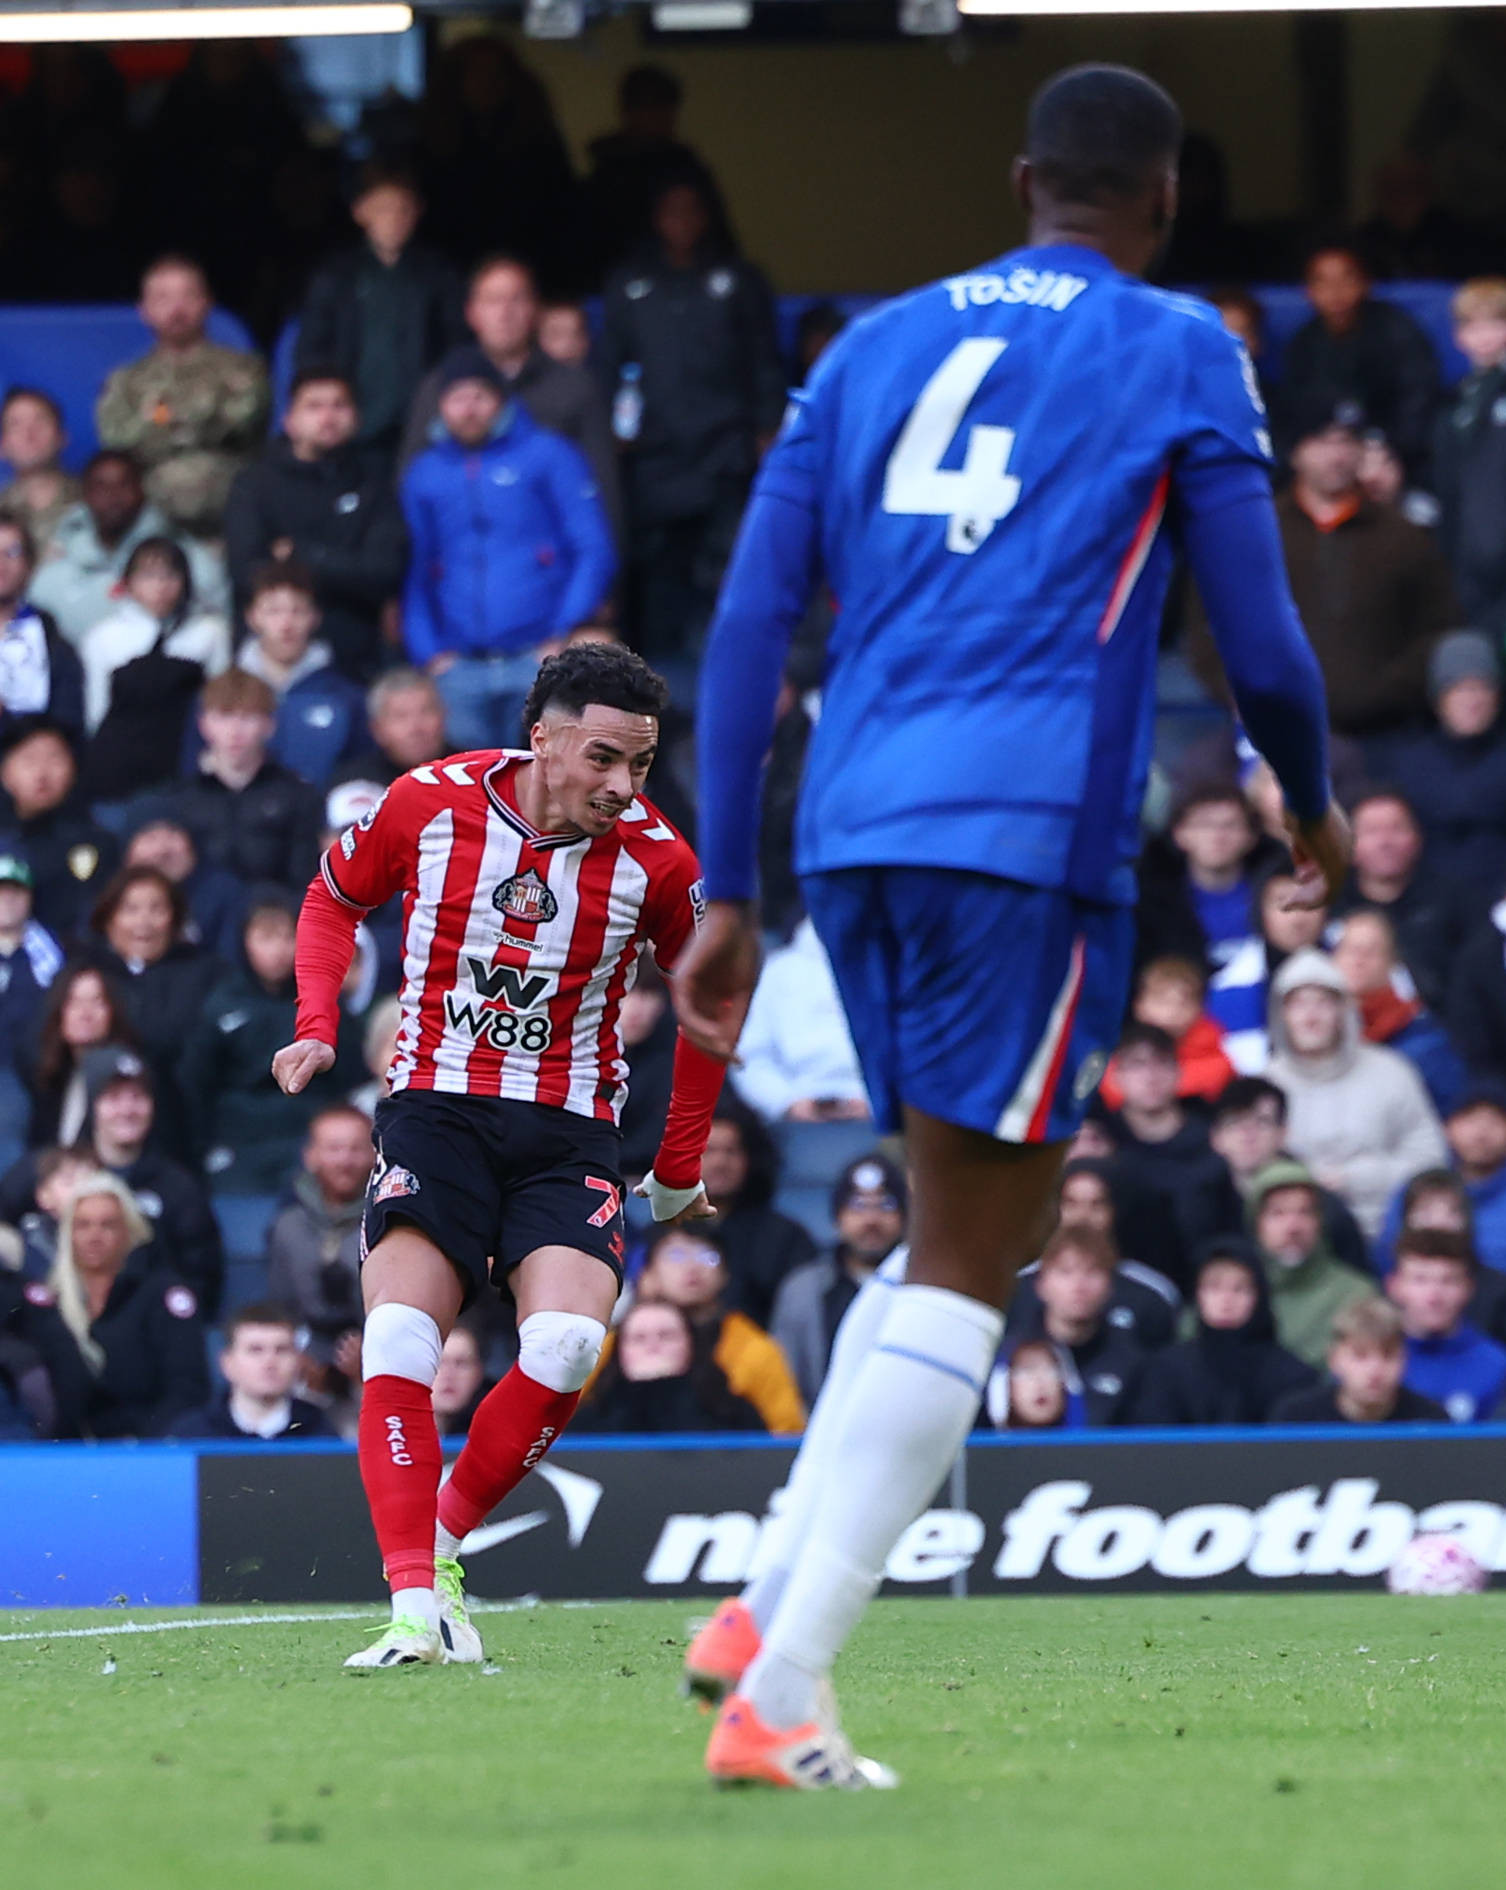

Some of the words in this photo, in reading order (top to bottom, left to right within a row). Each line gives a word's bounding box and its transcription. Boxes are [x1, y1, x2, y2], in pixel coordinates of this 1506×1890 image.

[942, 266, 1089, 312] TOSIN
[881, 336, 1022, 555] 4
[504, 934, 544, 953] hummel
[446, 994, 550, 1053] W88
[585, 1175, 620, 1229] 7
[384, 1415, 414, 1467] SAFC
[522, 1426, 556, 1469] SAFC
[643, 1484, 987, 1584] nie
